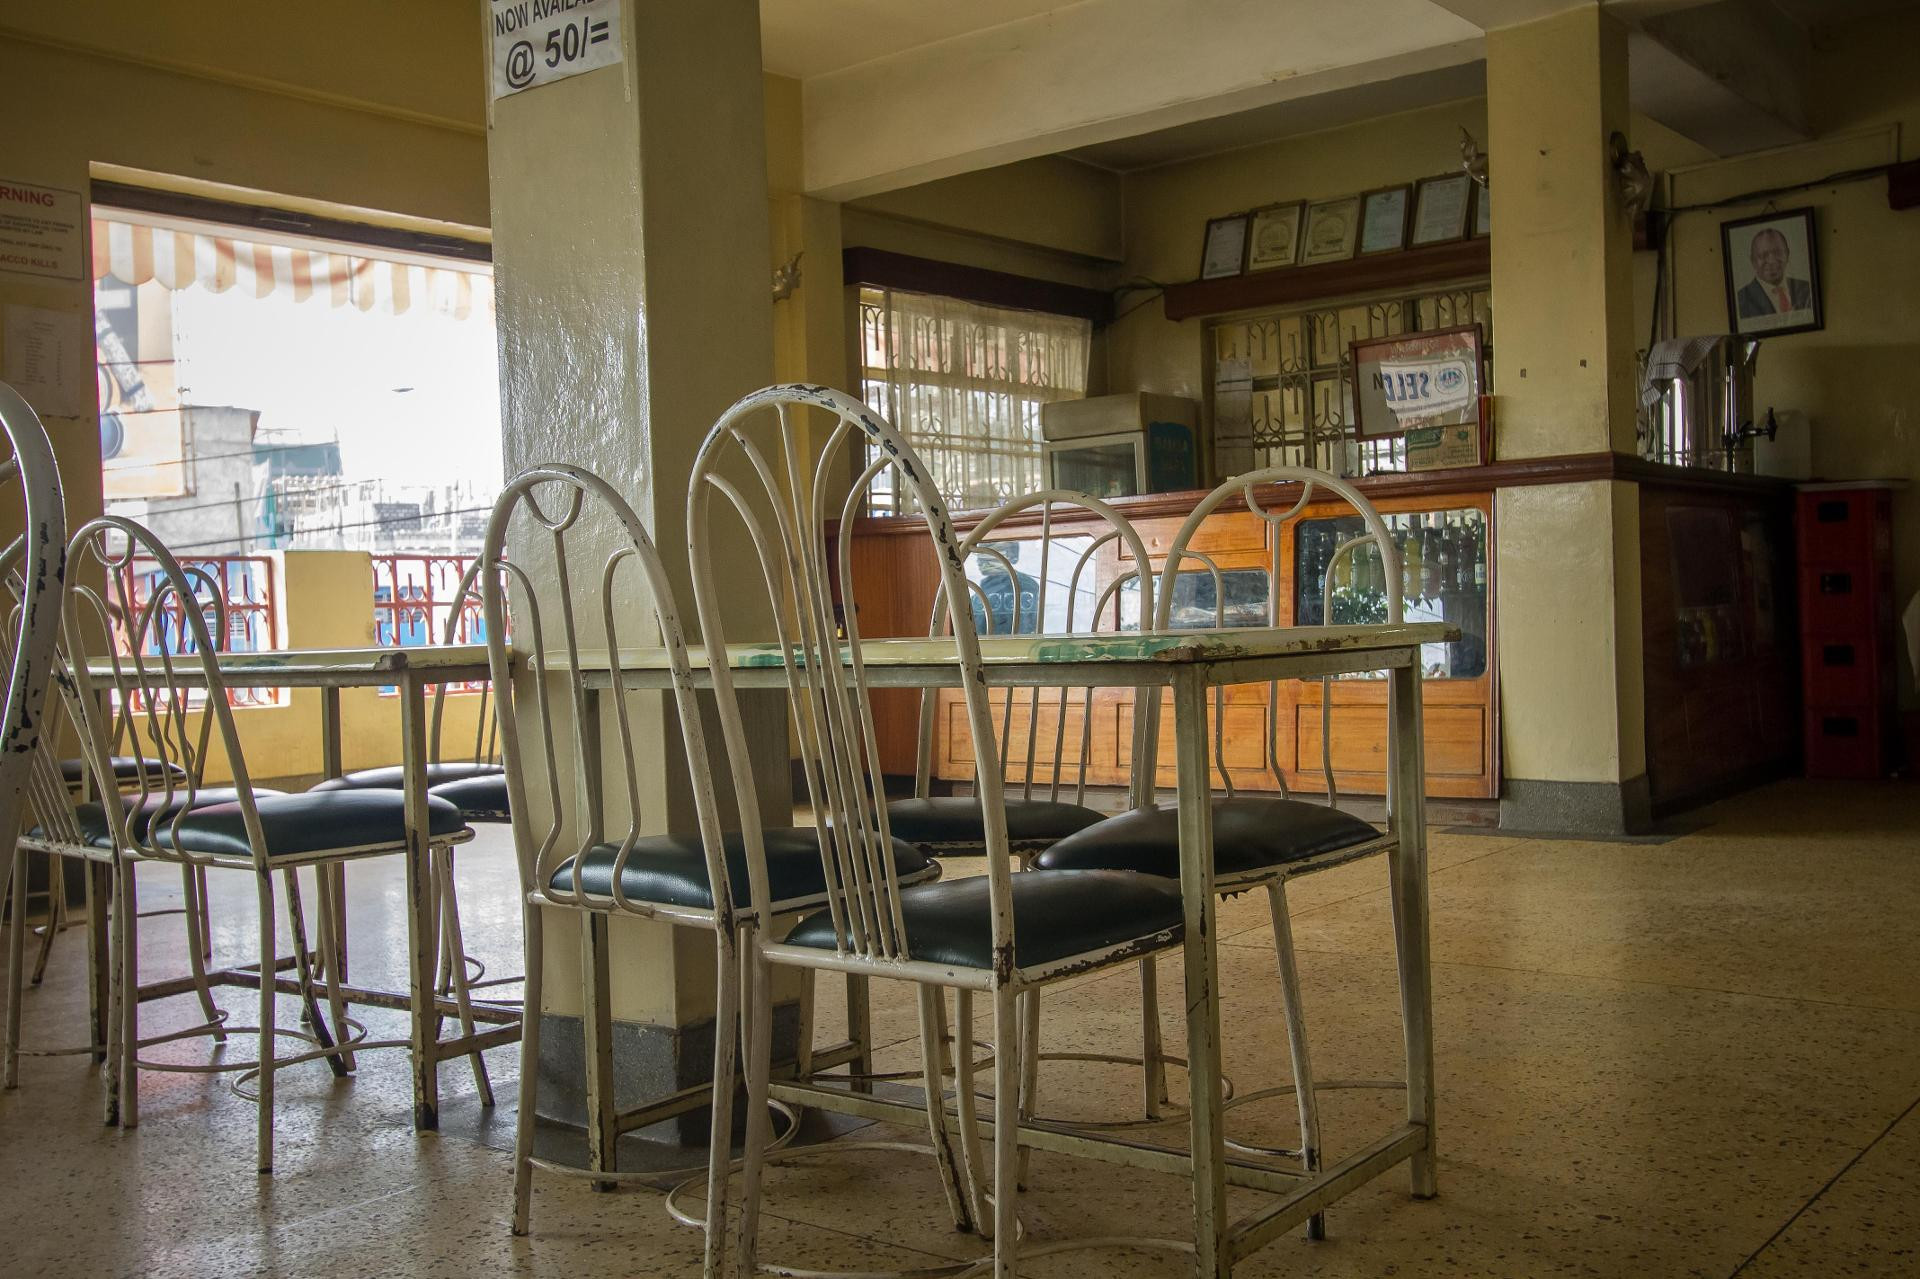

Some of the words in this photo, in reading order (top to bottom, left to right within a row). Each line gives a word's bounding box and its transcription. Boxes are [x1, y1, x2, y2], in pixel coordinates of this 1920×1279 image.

[496, 2, 528, 36] NOW
[533, 0, 595, 23] AVAIL
[505, 40, 536, 89] @
[545, 16, 609, 68] 50/=
[0, 186, 54, 207] RNING
